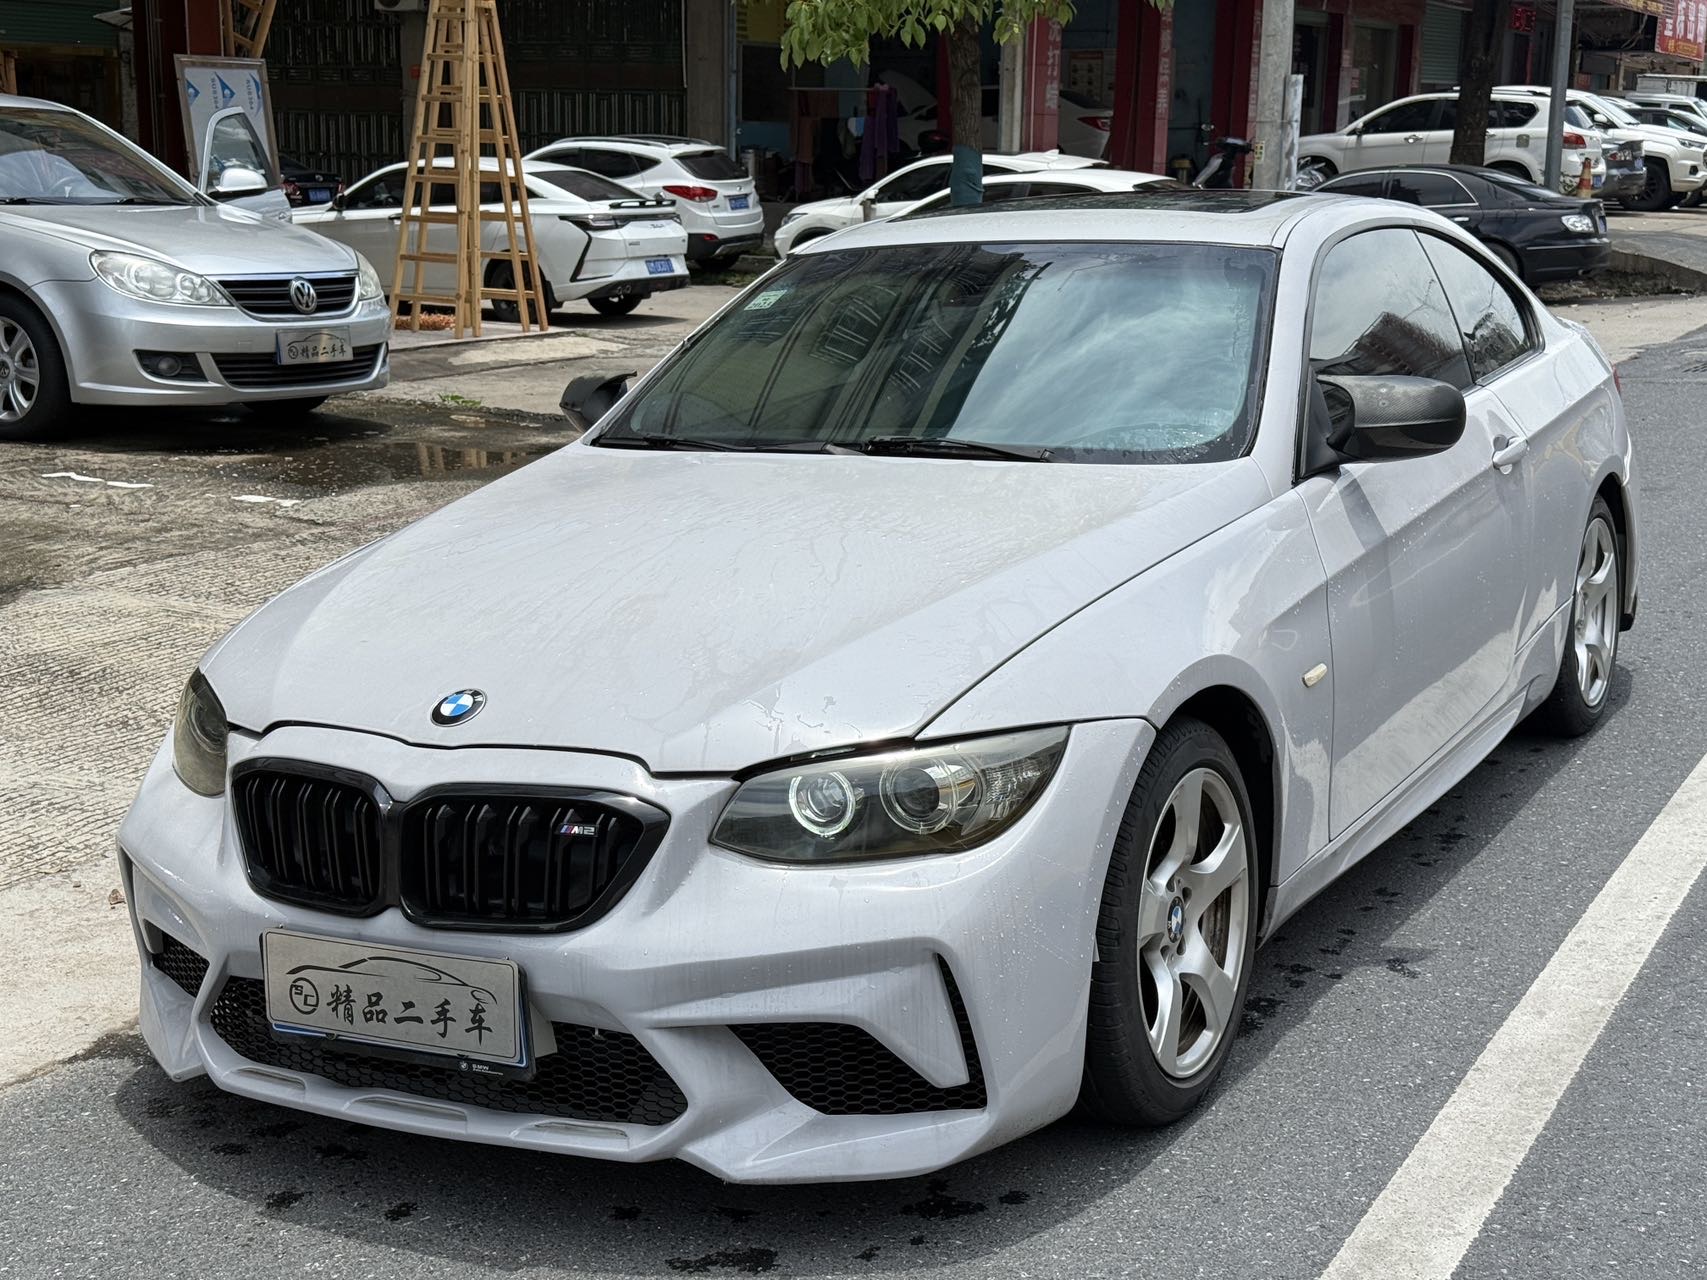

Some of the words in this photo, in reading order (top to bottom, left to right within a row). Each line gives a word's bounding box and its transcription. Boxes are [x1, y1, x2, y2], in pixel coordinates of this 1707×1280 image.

[300, 342, 347, 360] 精品二手车
[326, 983, 493, 1045] 精品二手车
